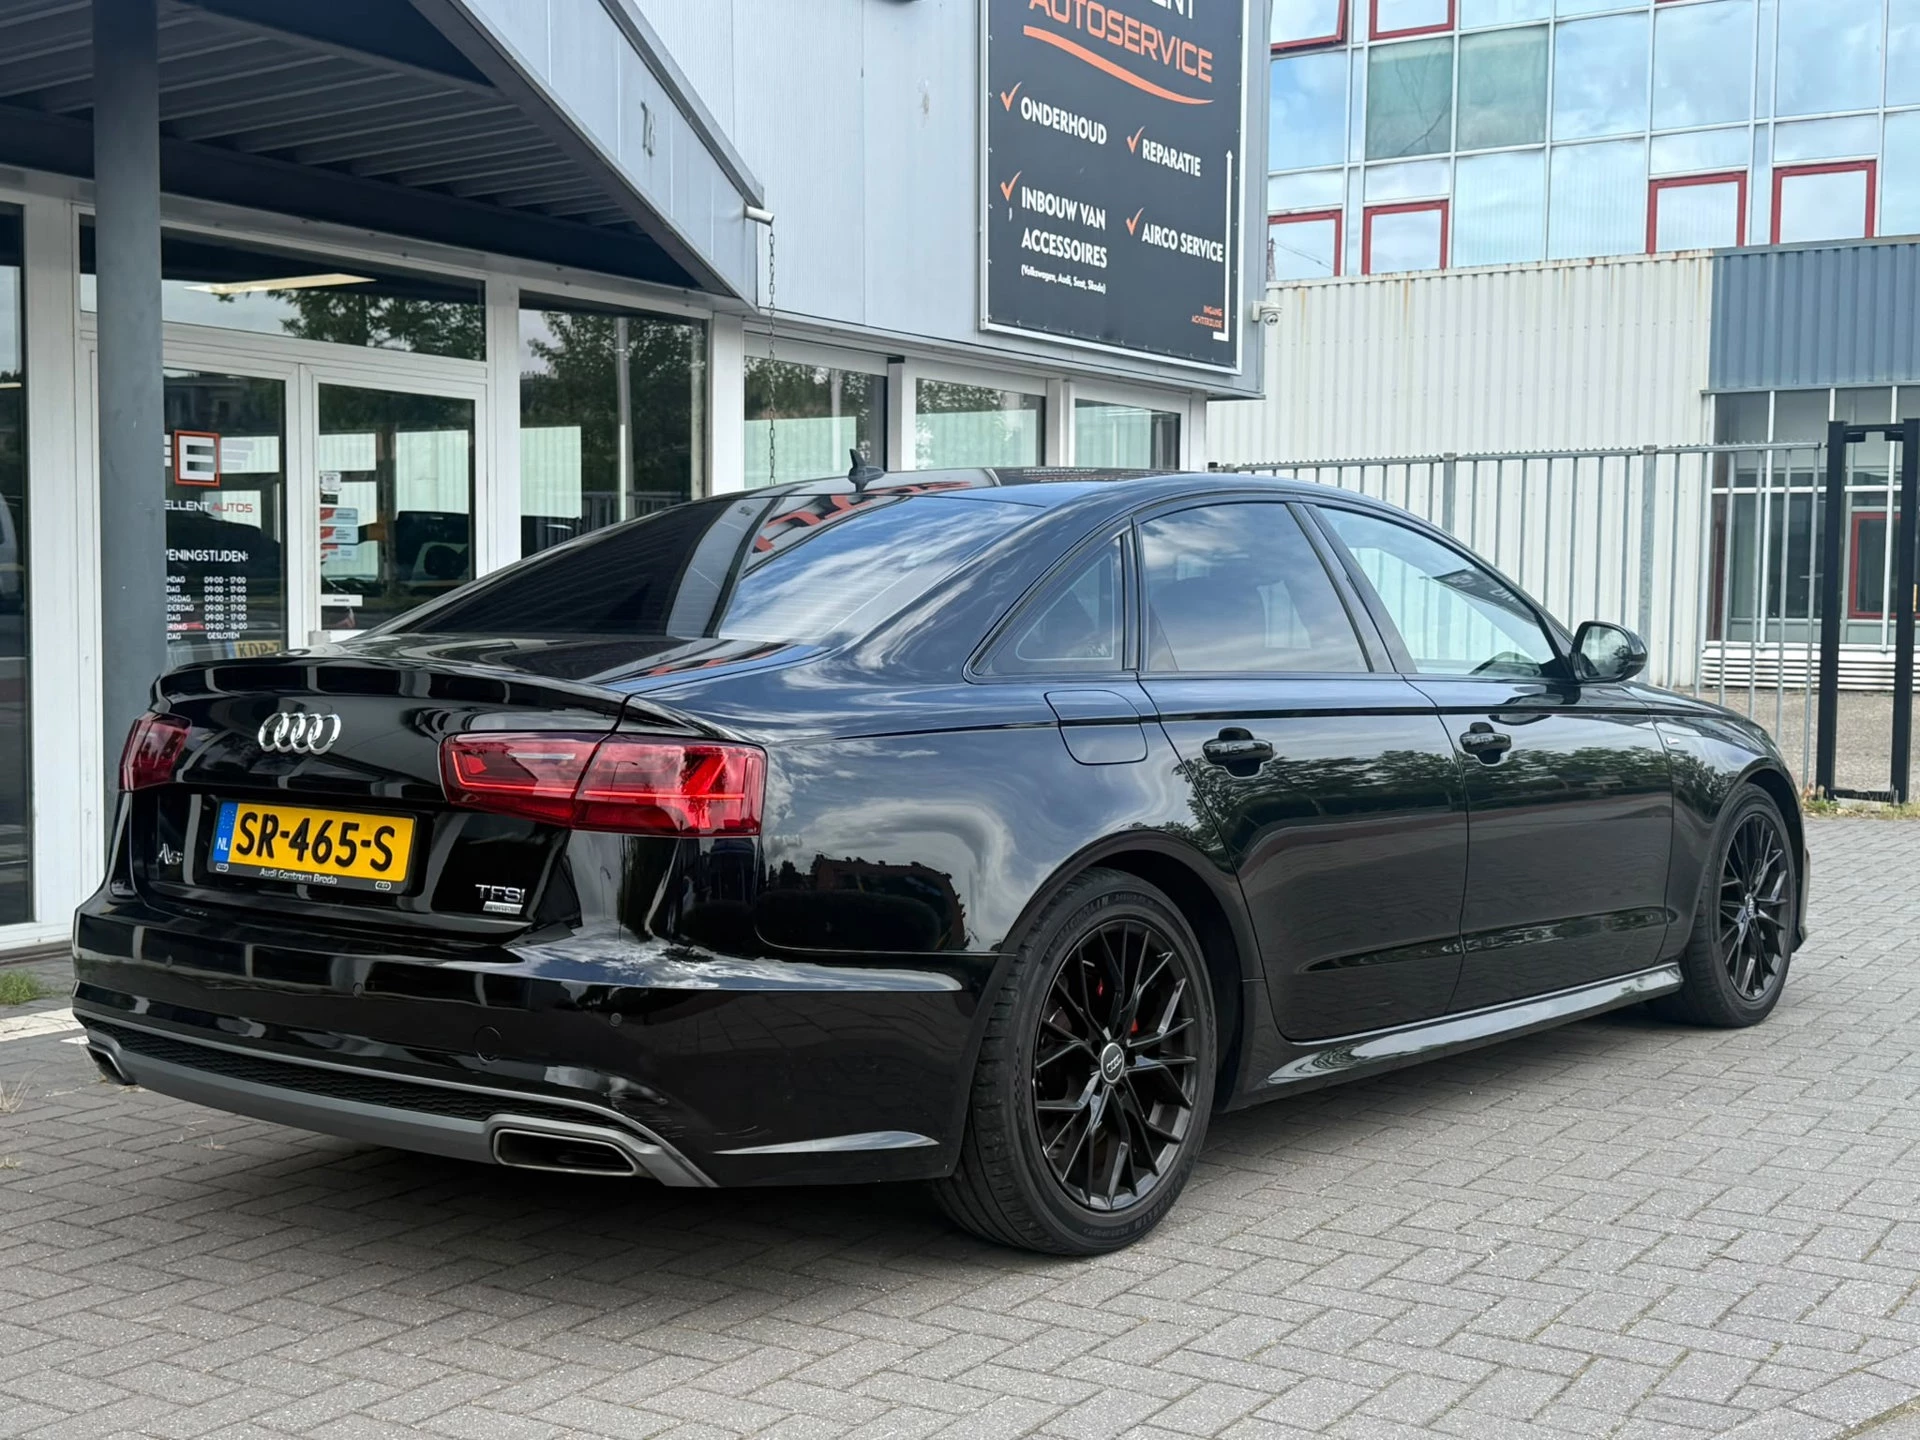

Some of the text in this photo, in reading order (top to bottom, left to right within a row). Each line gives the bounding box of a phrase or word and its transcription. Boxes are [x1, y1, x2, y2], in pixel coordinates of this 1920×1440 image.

[1020, 96, 1107, 145] ONDERHOUD
[1142, 138, 1202, 177] REPARATIE
[1021, 186, 1106, 231] INBOUW VAN
[1021, 227, 1107, 269] ACCESSOIRES
[1141, 222, 1224, 263] AIRCO SERVICE
[211, 502, 253, 513] AUTOS
[207, 631, 240, 640] GESLOTEN
[216, 838, 229, 851] NL
[235, 812, 396, 872] SR-465-S
[259, 867, 277, 879] Audi
[475, 884, 525, 903] TFSI
